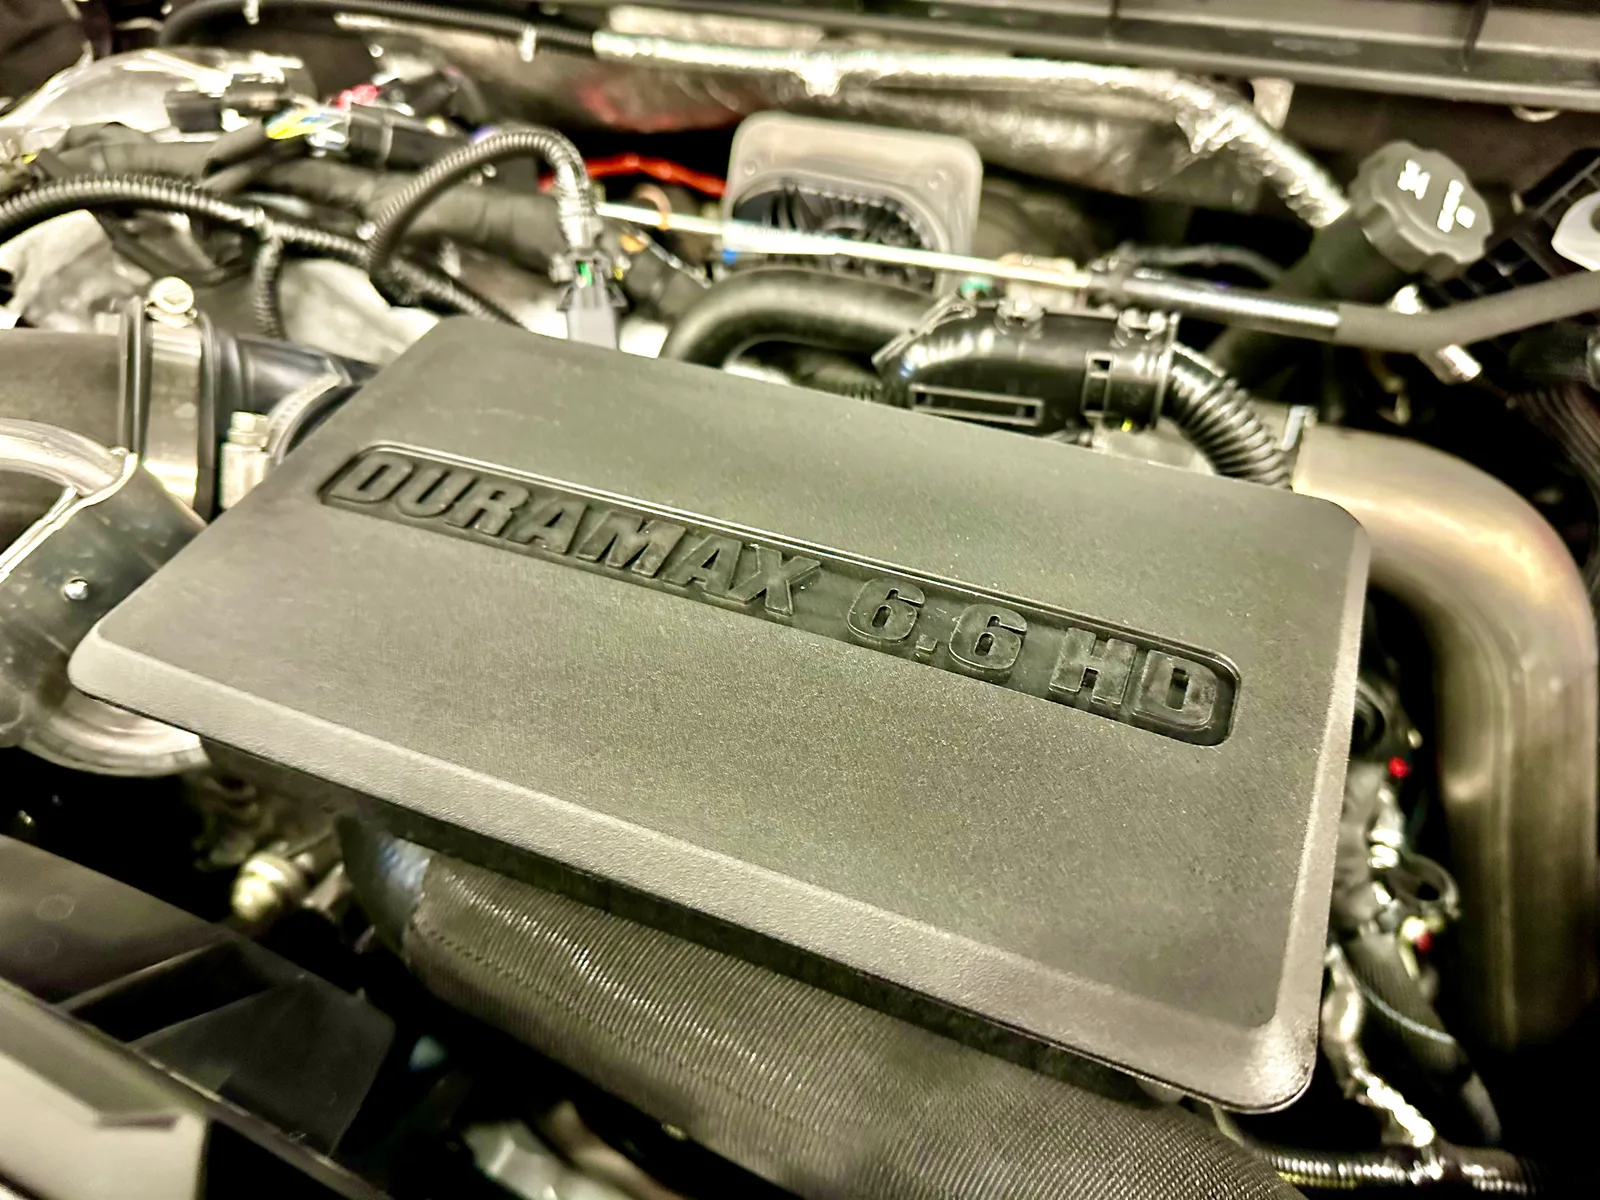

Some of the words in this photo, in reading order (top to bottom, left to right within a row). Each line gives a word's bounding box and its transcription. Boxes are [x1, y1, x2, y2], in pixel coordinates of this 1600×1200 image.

[329, 452, 821, 616] DURAMAX
[846, 577, 1028, 673] 6.6
[1048, 626, 1218, 731] HD
